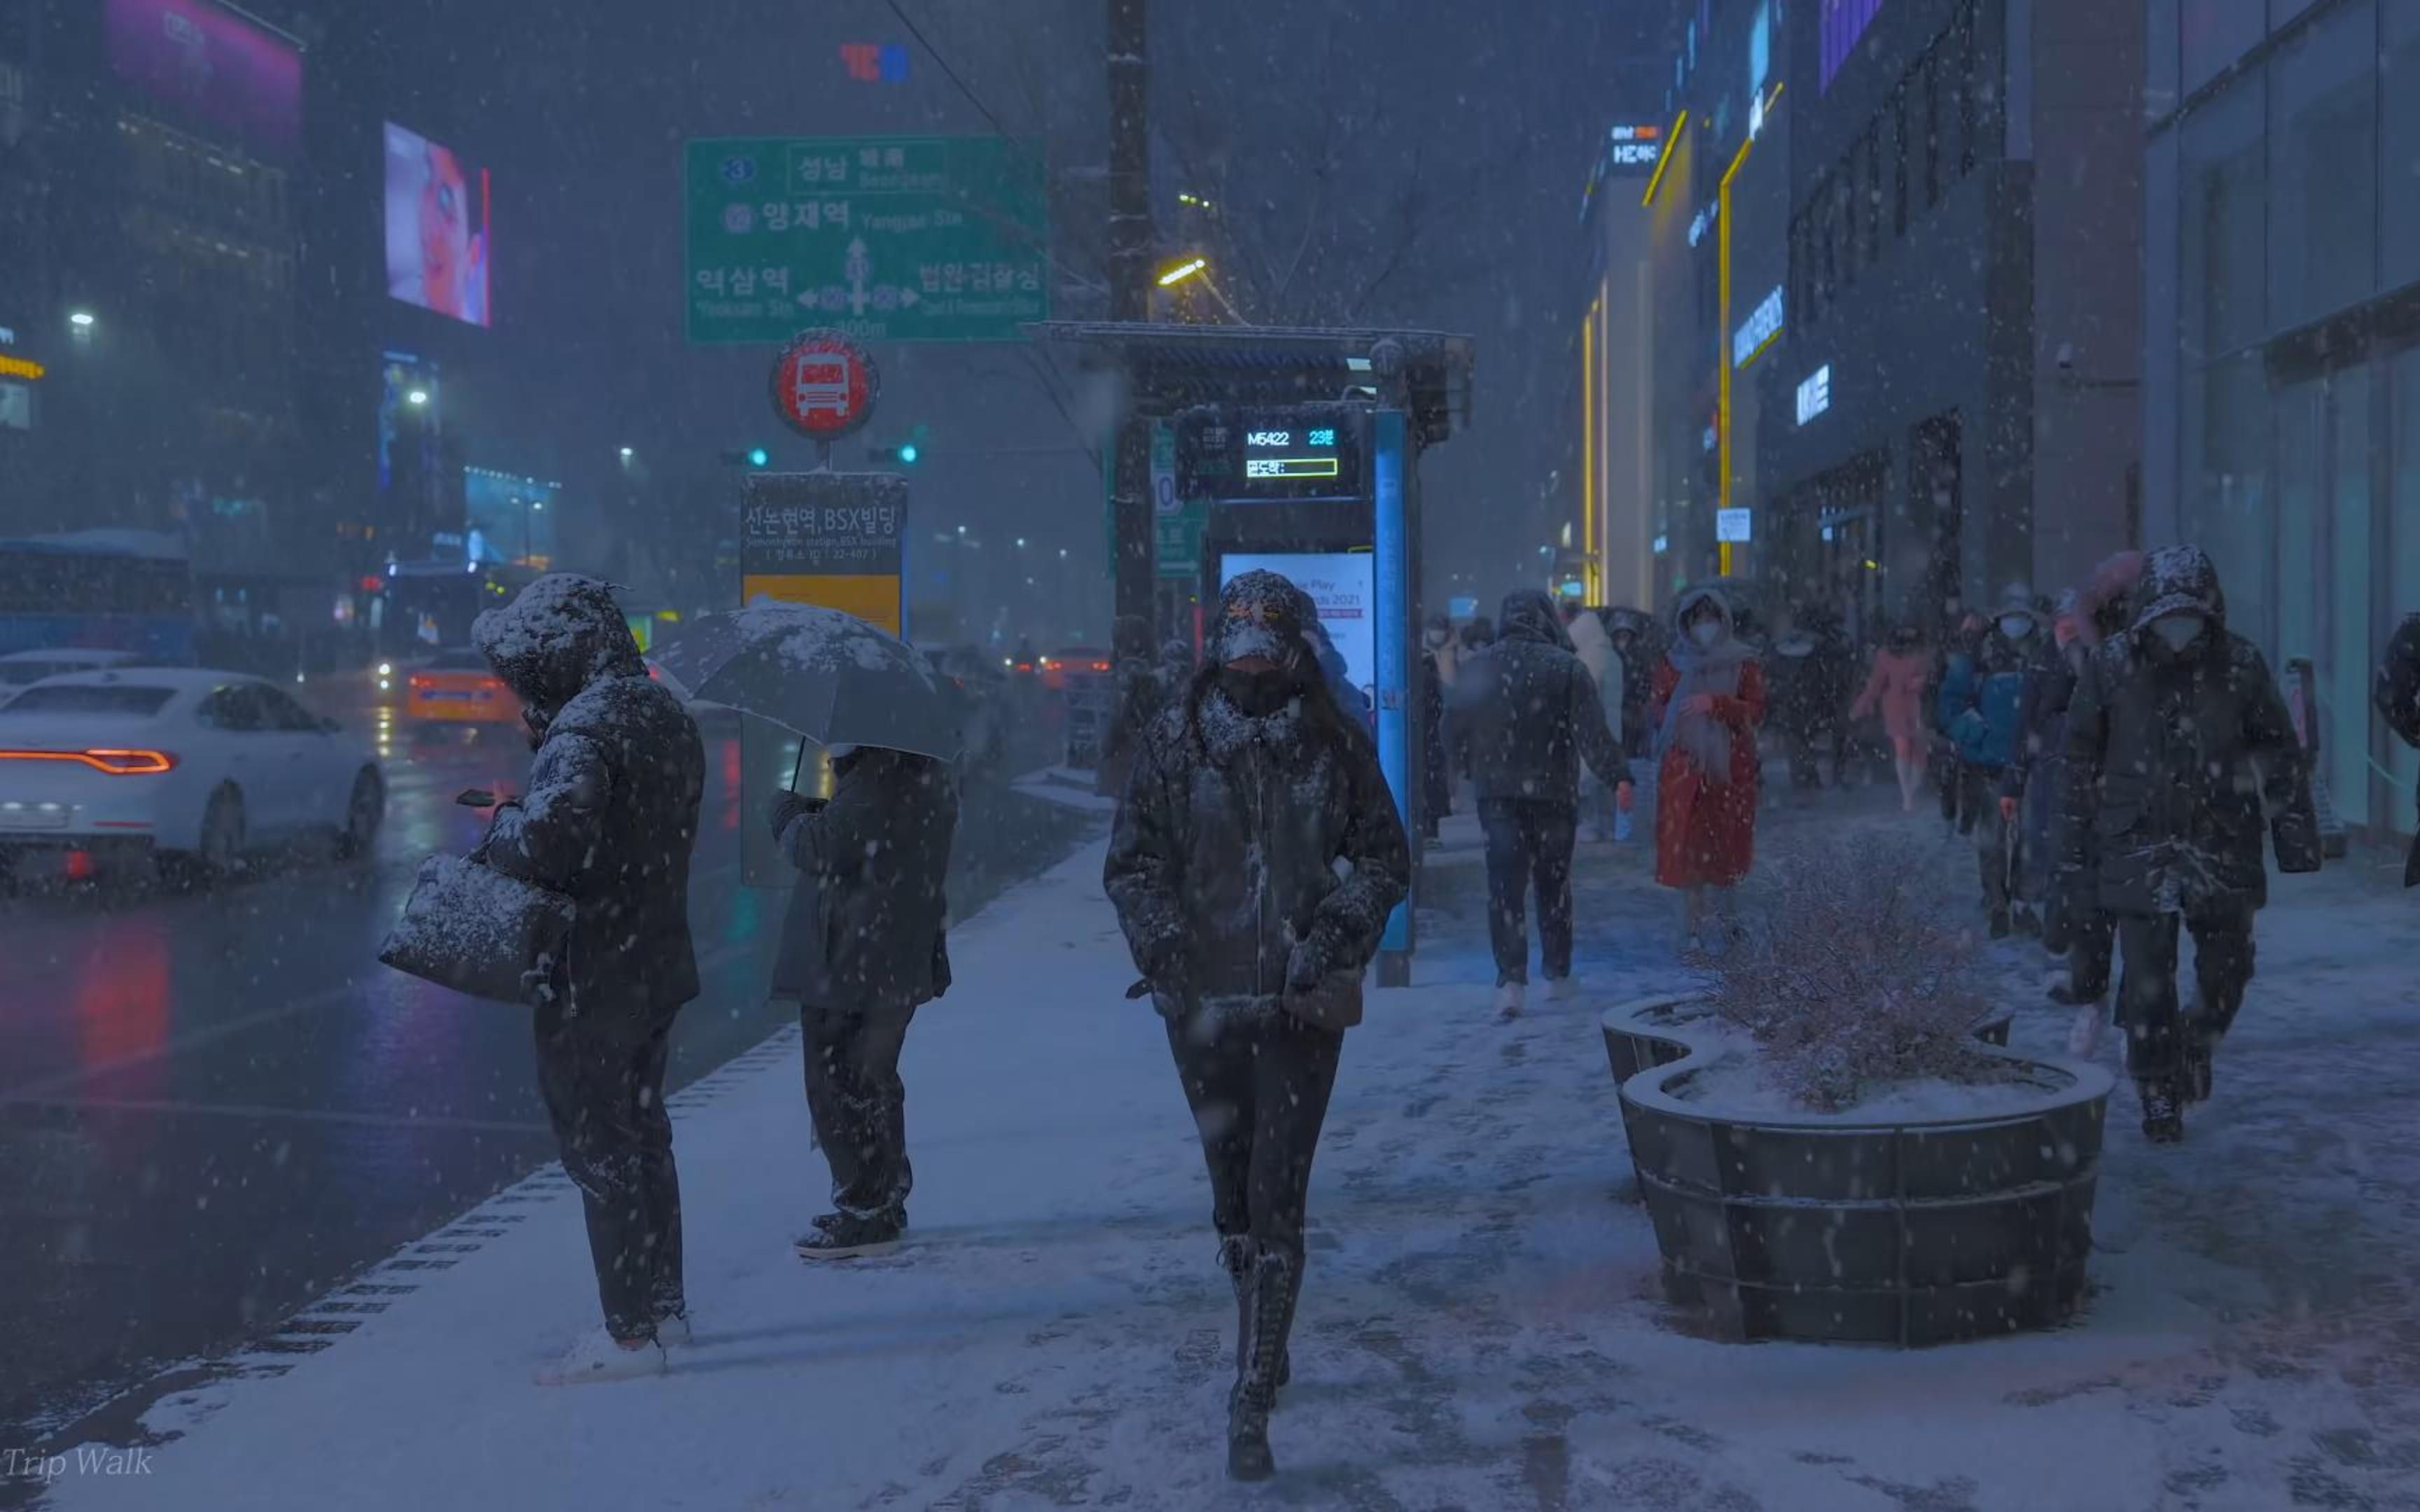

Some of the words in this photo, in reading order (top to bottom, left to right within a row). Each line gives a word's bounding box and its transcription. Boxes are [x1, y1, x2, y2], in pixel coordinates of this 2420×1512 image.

[798, 156, 848, 181] 성남
[763, 200, 849, 232] 양재역
[695, 266, 789, 298] 역삼역
[1247, 432, 1289, 447] M5422
[1309, 429, 1335, 446] 23분
[1333, 594, 1359, 605] 2021
